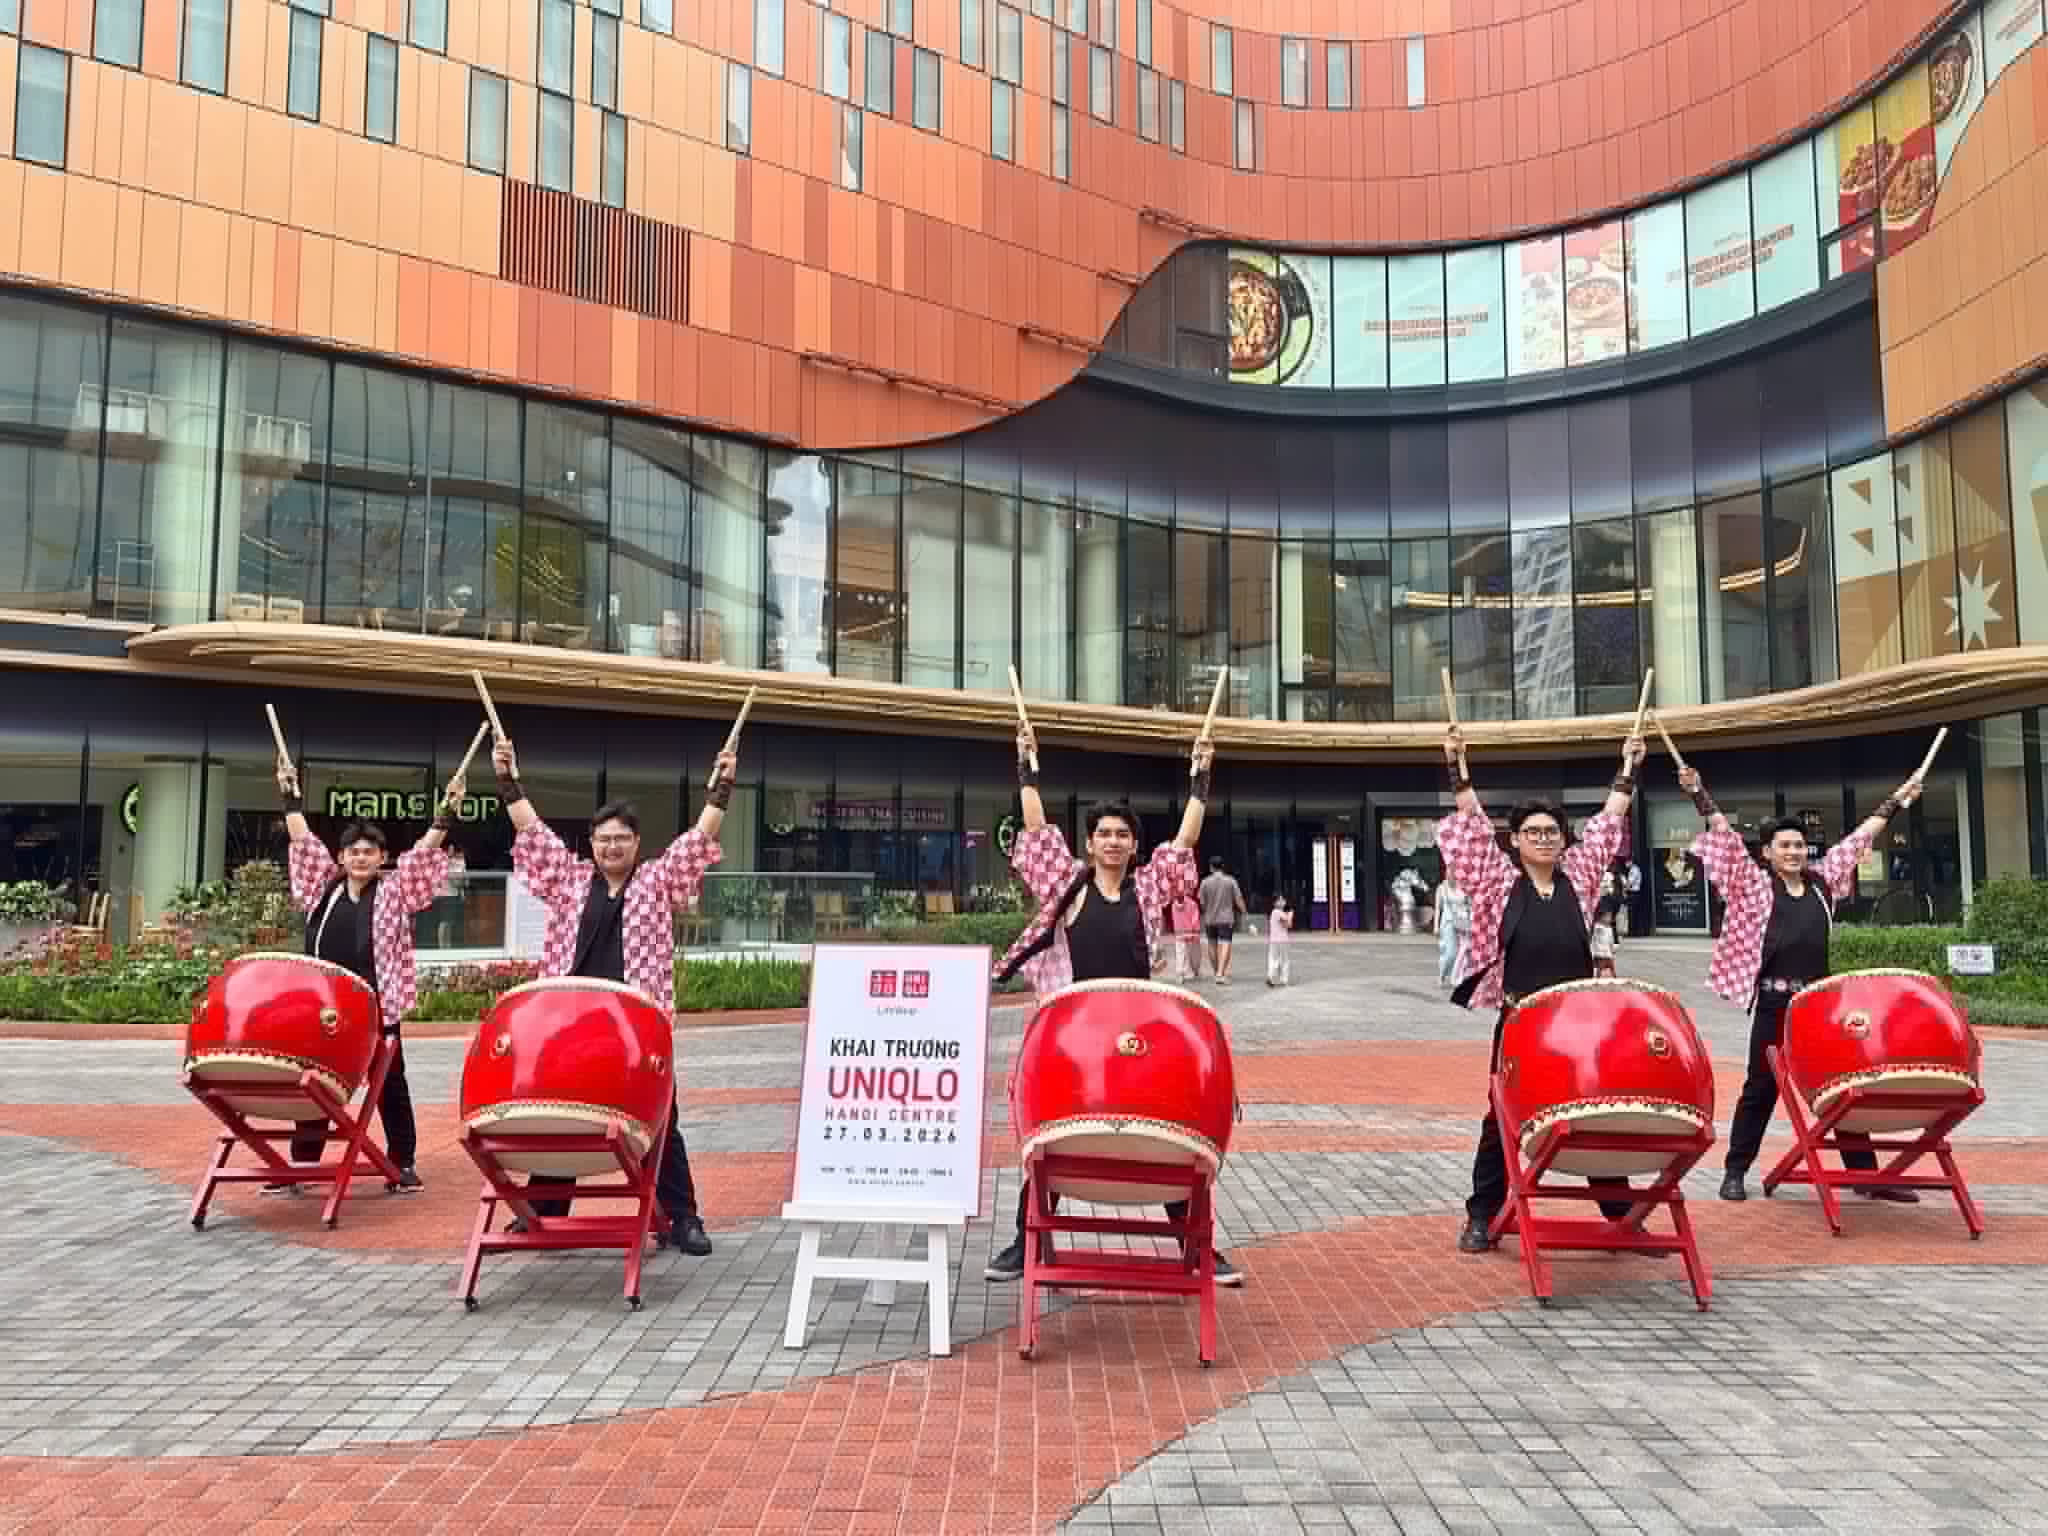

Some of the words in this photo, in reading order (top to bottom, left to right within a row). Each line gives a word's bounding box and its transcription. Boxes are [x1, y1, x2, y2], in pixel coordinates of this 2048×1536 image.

[830, 1039, 875, 1057] KHAI
[827, 1066, 959, 1104] UNIQLO
[824, 1107, 878, 1121] HANOI
[888, 1108, 957, 1123] CENTRE
